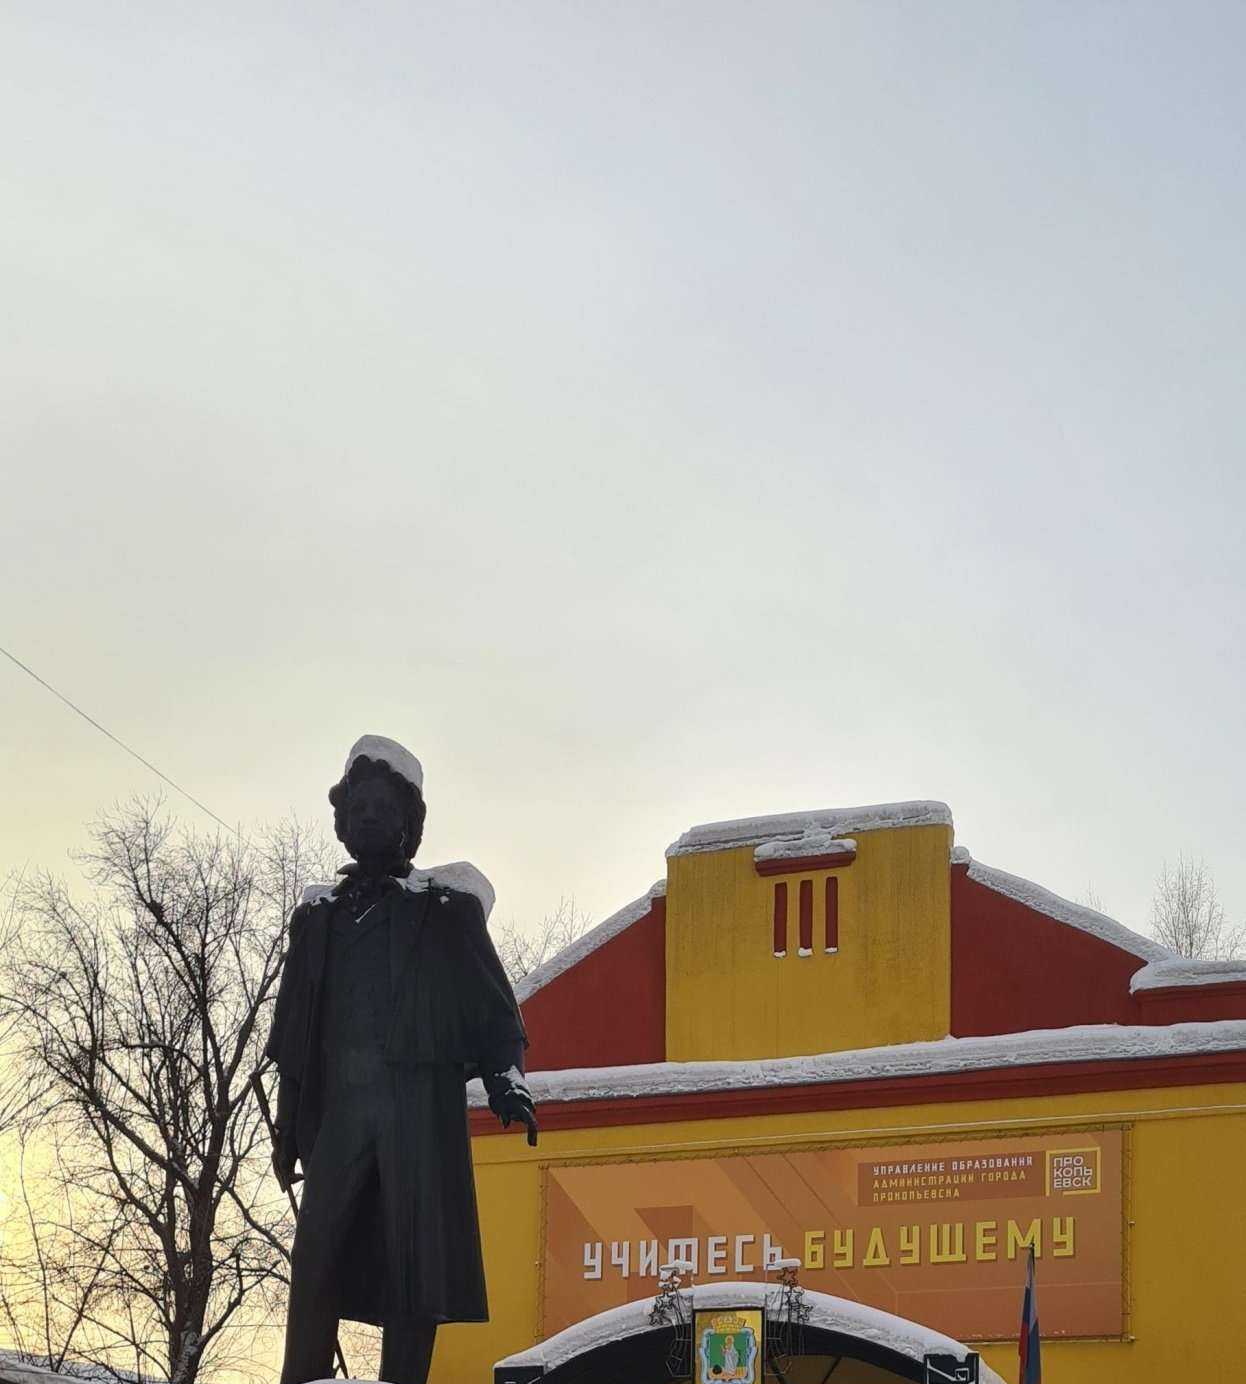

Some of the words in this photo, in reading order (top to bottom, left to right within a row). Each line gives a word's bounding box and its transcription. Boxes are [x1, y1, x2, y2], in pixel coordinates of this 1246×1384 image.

[873, 1162, 945, 1176] УПРАВЛЕНИЕ
[952, 1156, 1033, 1171] ОБРАЗОВАНИЯ
[1053, 1156, 1084, 1167] ПРО
[1053, 1166, 1093, 1178] КОПЬ
[872, 1174, 975, 1189] АДМИНИСТРАЦИИ
[981, 1170, 1027, 1183] ГОРОДА
[1053, 1177, 1092, 1189] ЕВСК
[873, 1188, 960, 1202] ПРОКОПЬЕВСКА
[584, 1234, 783, 1279] УЧИТЕСЬ
[804, 1217, 1074, 1268] БУДУЩЕМУ
